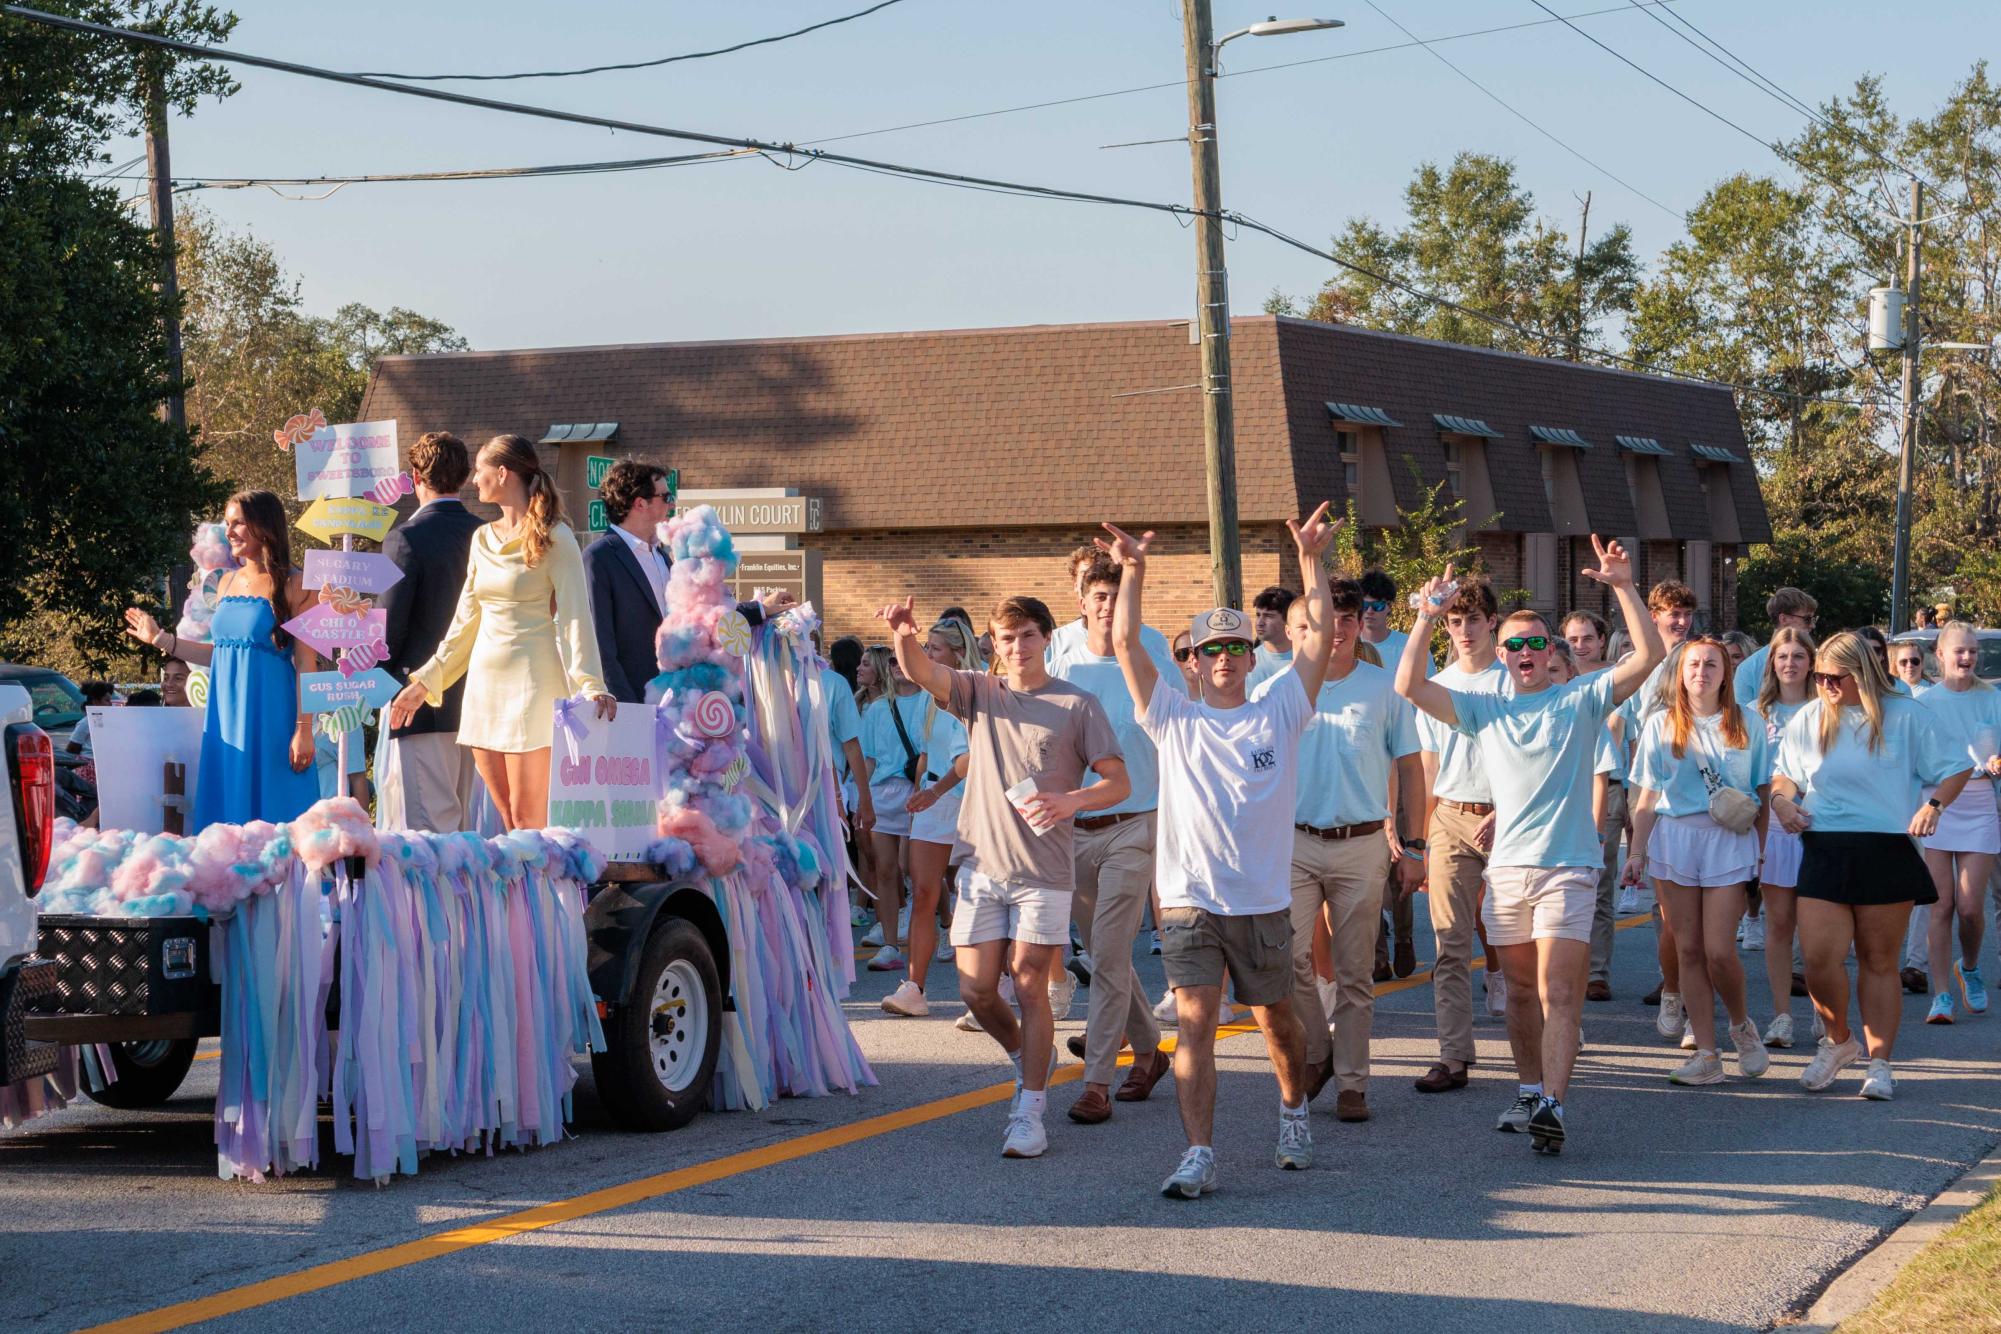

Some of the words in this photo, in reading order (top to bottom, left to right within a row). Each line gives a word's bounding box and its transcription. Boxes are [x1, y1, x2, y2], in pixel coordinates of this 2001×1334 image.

[309, 435, 391, 452] WELCOME
[340, 452, 361, 464] TO
[591, 504, 608, 528] CH
[750, 504, 800, 525] COURT
[741, 563, 763, 571] Franklin
[313, 574, 372, 587] STADIUM
[311, 628, 365, 640] CASTLE
[335, 680, 376, 690] SUGAR
[327, 691, 360, 702] RUSH
[594, 755, 651, 786] OMEGA
